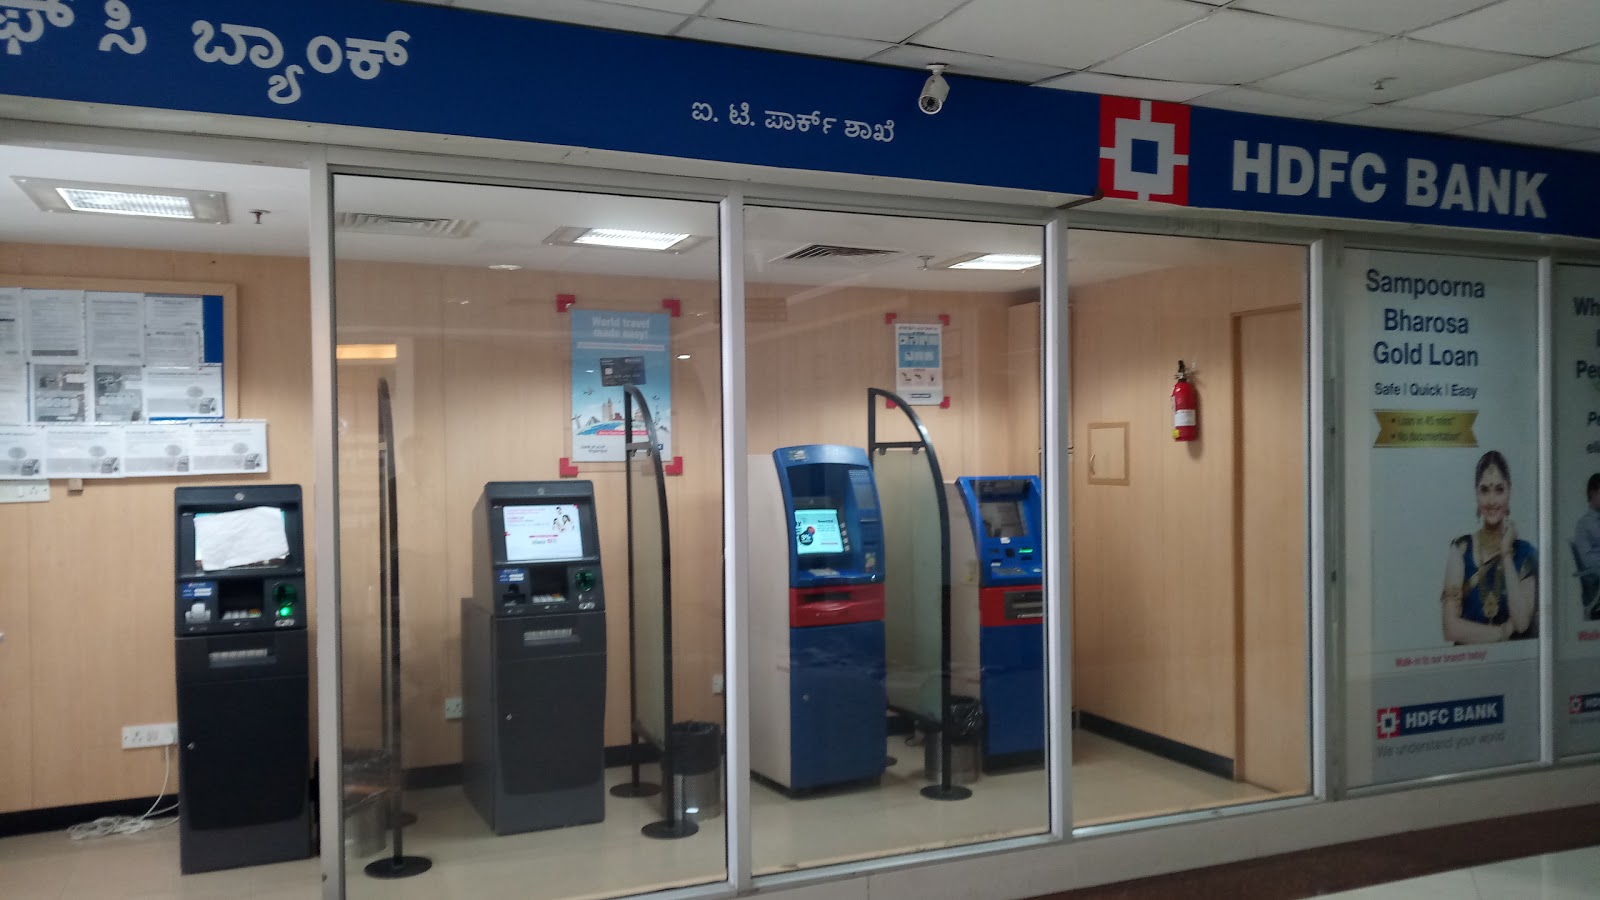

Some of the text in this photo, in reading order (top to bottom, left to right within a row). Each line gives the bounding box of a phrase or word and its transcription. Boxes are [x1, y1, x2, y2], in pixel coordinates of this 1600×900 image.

[191, 20, 411, 105] ಬ್ಯಾಂಕ್
[764, 110, 837, 135] ಪಾರ್ಕ್
[844, 119, 895, 143] ಶಾಖೆ
[1232, 139, 1549, 220] HDFC BANK
[1366, 268, 1486, 299] Sampoorna
[1384, 308, 1470, 334] Bharosa
[1373, 341, 1479, 367] Gold Loan
[1374, 382, 1478, 400] Safe Quick Easy
[1405, 702, 1498, 729] HDFC BANK
